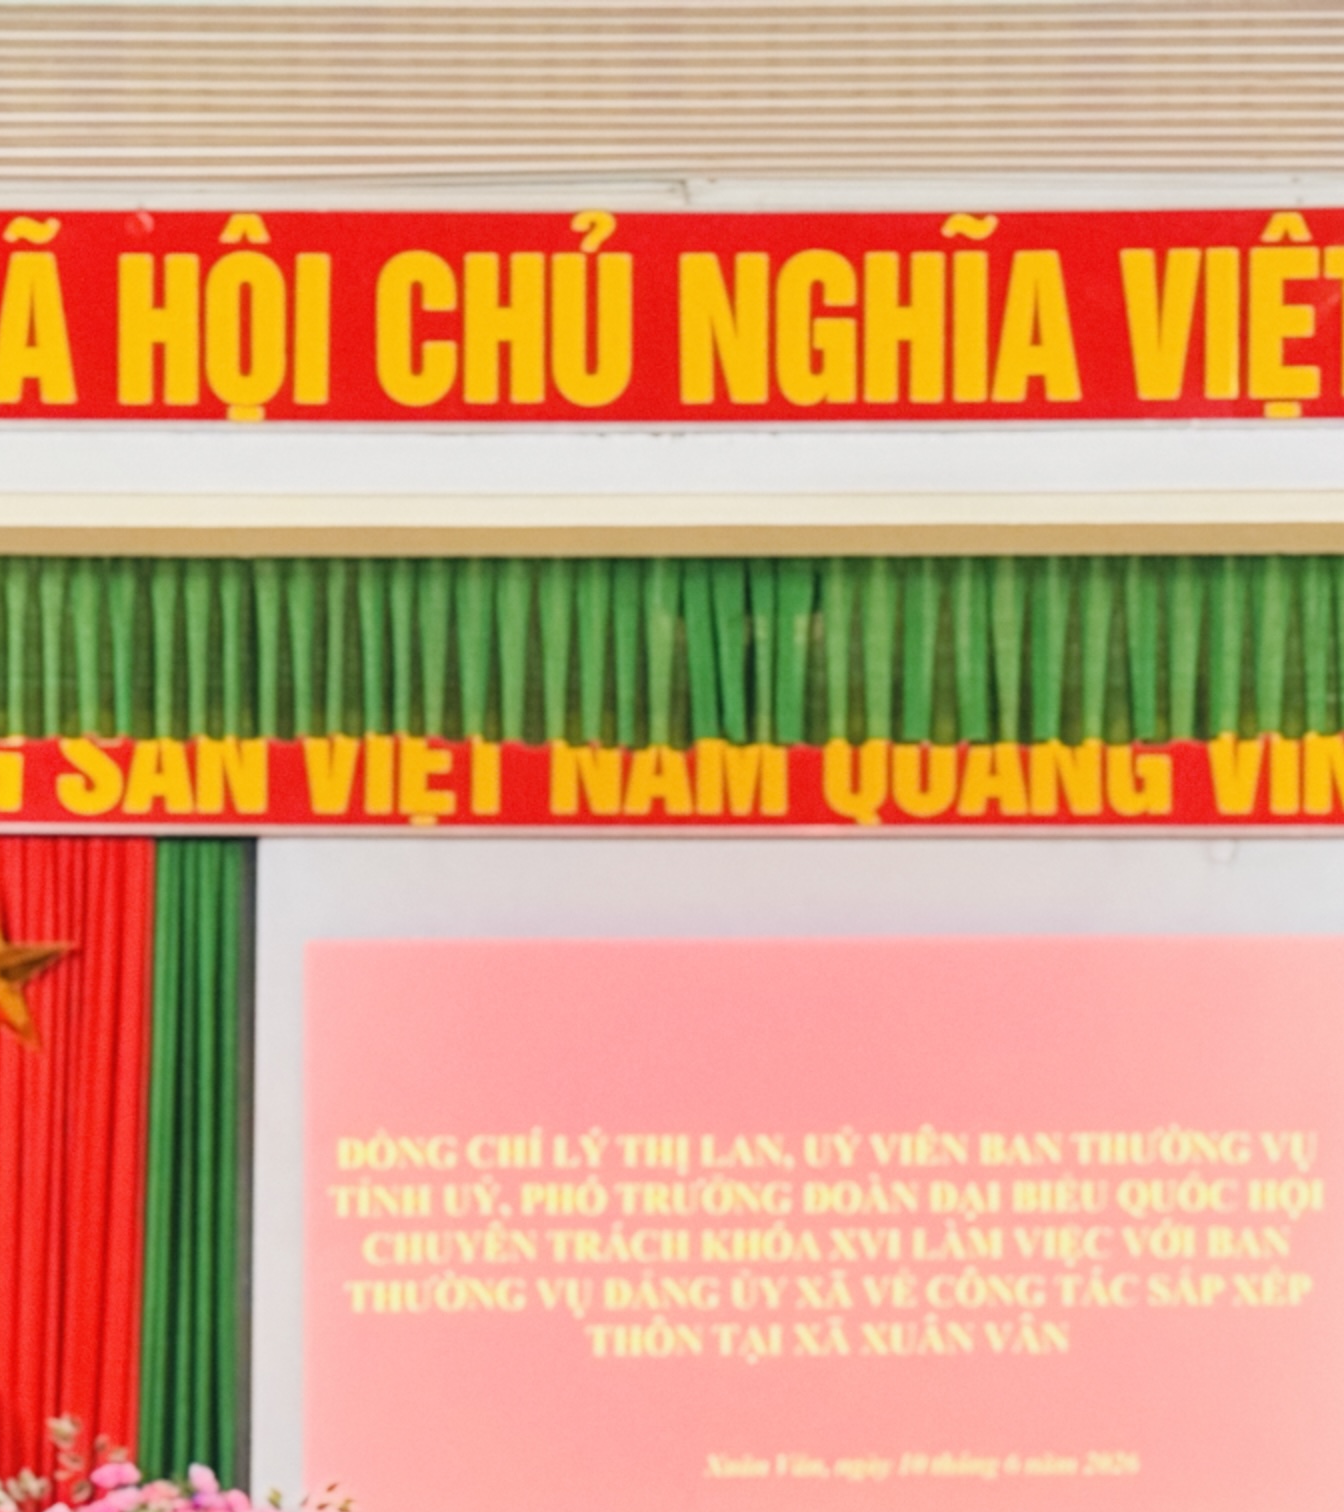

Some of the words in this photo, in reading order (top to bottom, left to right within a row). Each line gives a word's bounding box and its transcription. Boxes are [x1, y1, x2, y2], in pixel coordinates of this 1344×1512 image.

[117, 211, 332, 422] HỘI
[375, 210, 633, 408] CHỦ
[678, 212, 1082, 407] NGHĨA
[549, 738, 789, 816] NAM
[821, 738, 1173, 826] QUANG
[466, 1126, 543, 1169] CHÍ
[616, 1133, 690, 1176] THỊ
[700, 1133, 794, 1171] LAN,
[869, 1123, 968, 1166] VIÊN
[978, 1131, 1063, 1166] BAN
[1069, 1123, 1250, 1167] THƯỜNG
[1260, 1130, 1316, 1173] VỤ
[520, 1174, 609, 1217] PHÓ
[803, 1172, 919, 1215] ĐOÀN
[927, 1180, 1002, 1221] ĐẠI
[1115, 1171, 1237, 1219] QUỐC
[1247, 1173, 1324, 1220] HỘI
[362, 1220, 538, 1265] CHUYÊN
[547, 1221, 691, 1262] TRÁCH
[700, 1221, 822, 1262] KHÓA
[829, 1227, 902, 1261] XVI
[912, 1218, 1004, 1260] LÀM
[1012, 1226, 1113, 1268] VIỆC
[1120, 1217, 1197, 1260] VỚI
[1206, 1226, 1292, 1260] BAN
[345, 1270, 528, 1313] THƯỜNG
[535, 1278, 594, 1319] VỤ
[794, 1268, 854, 1310] XÃ
[924, 1265, 1045, 1309] CÔNG
[1055, 1266, 1141, 1307] TÁC
[586, 1315, 704, 1358] THÔN
[711, 1322, 784, 1365] TẠI
[793, 1317, 852, 1356] XÃ
[858, 1312, 975, 1355] XUÂN
